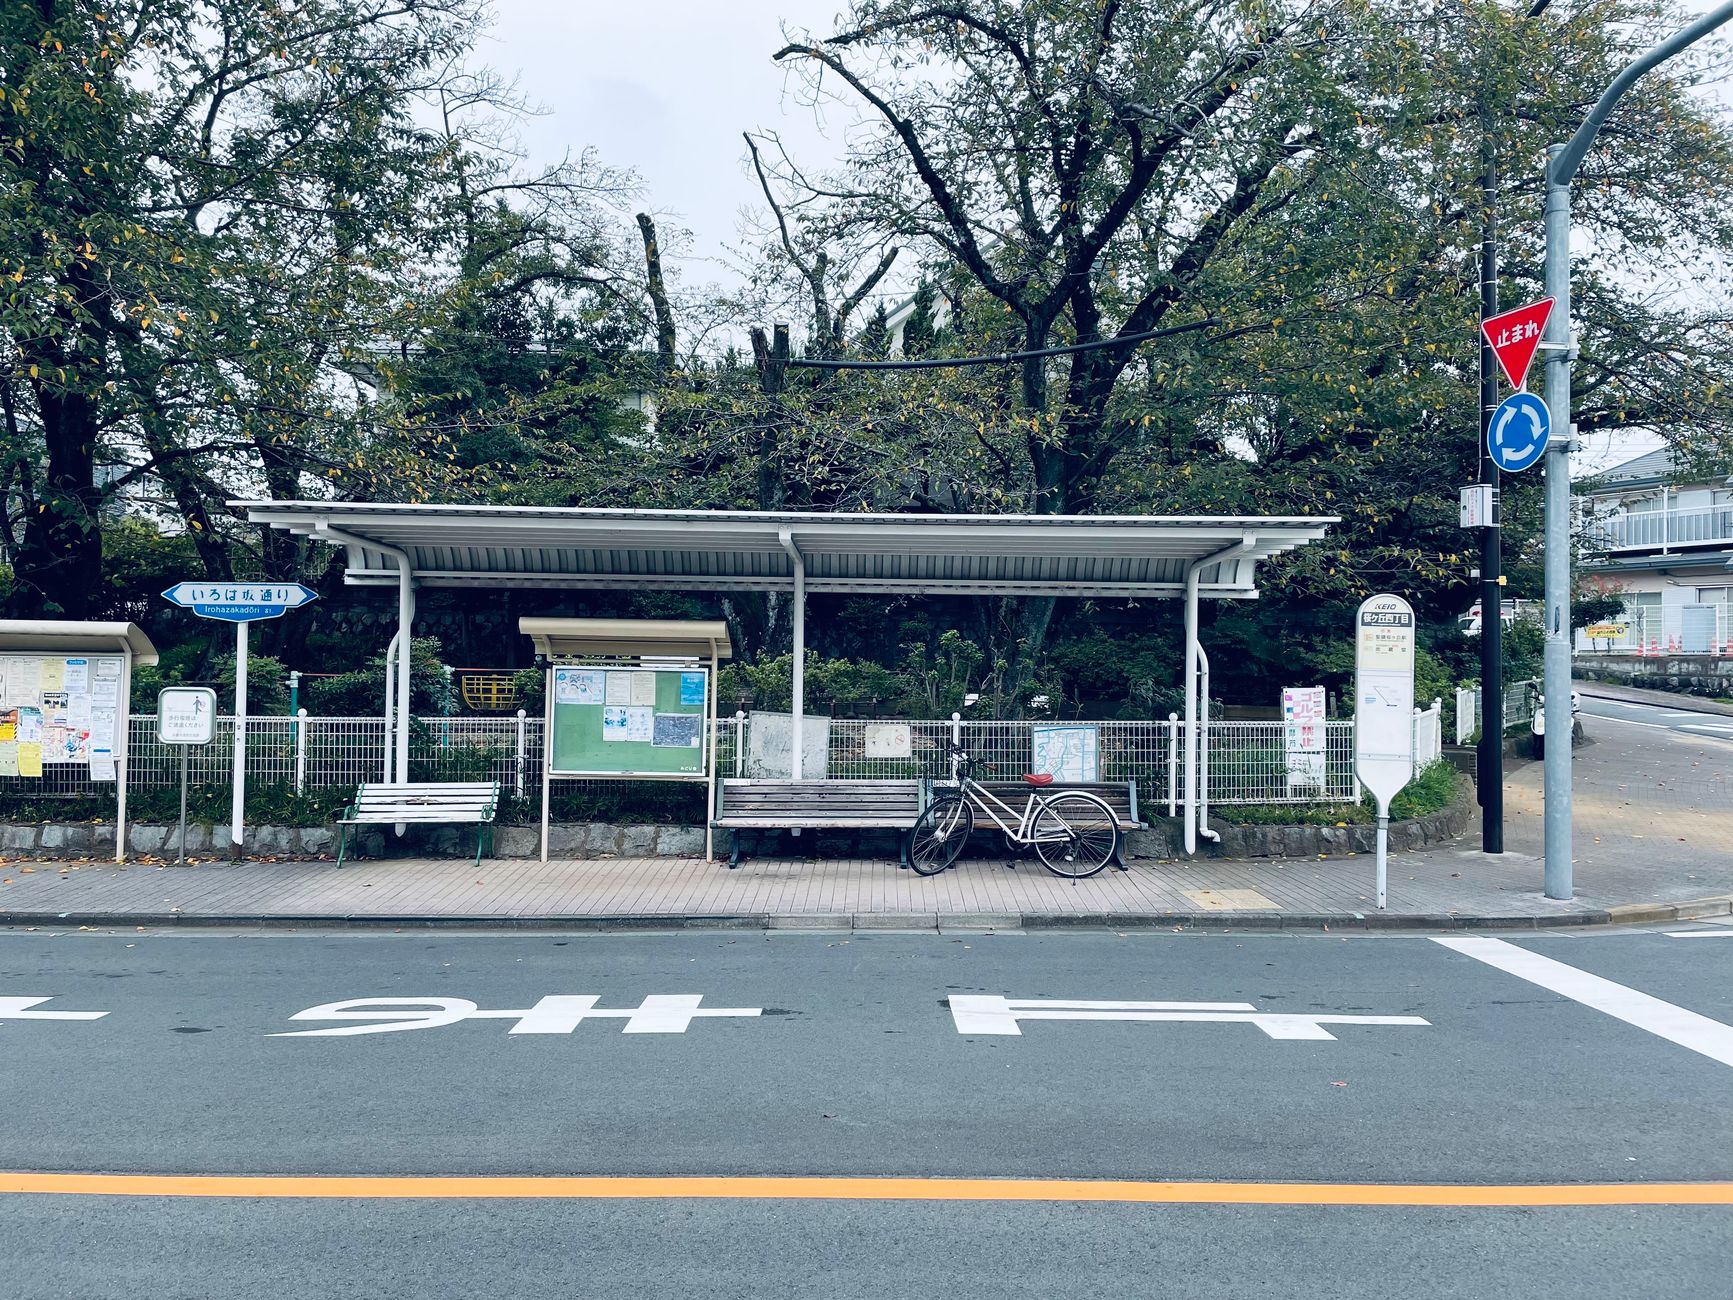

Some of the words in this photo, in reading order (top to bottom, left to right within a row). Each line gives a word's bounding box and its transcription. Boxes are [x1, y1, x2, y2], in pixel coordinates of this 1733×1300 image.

[1496, 320, 1540, 349] 止まれ
[192, 588, 289, 602] いろは坂通り
